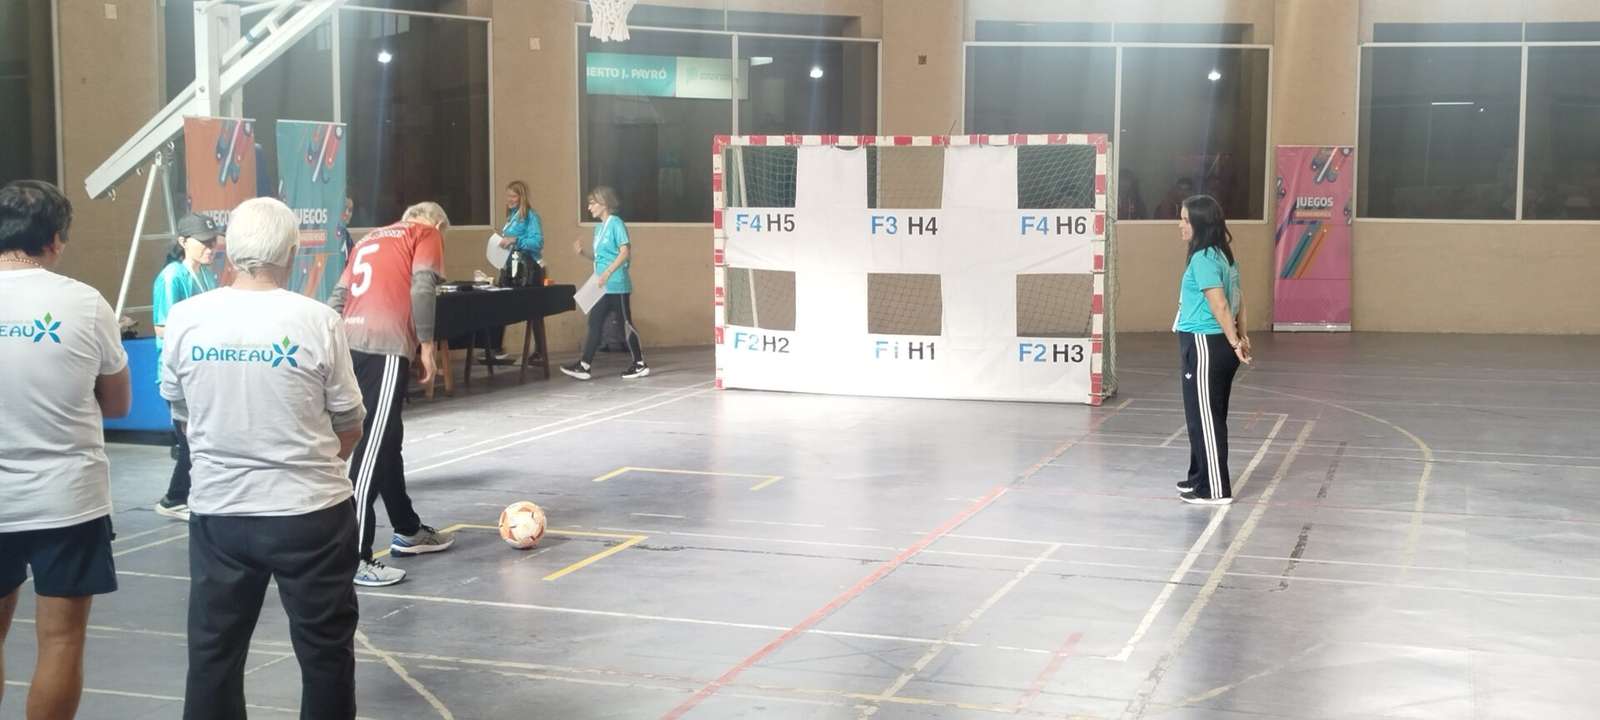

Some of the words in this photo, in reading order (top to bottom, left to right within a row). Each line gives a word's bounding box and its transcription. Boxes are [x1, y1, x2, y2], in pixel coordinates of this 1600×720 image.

[632, 67, 667, 79] PAYRÓ
[1296, 196, 1334, 208] JUEGOS
[736, 214, 762, 232] F4
[766, 214, 796, 232] H5
[871, 216, 898, 235] F3
[908, 216, 938, 235] H4
[1021, 216, 1049, 235] F4
[1056, 216, 1087, 235] H6
[351, 243, 380, 297] 5
[733, 332, 759, 351] F2
[763, 335, 790, 353] H2
[908, 342, 936, 360] H1
[1019, 343, 1047, 362] F2
[1052, 343, 1084, 363] H3
